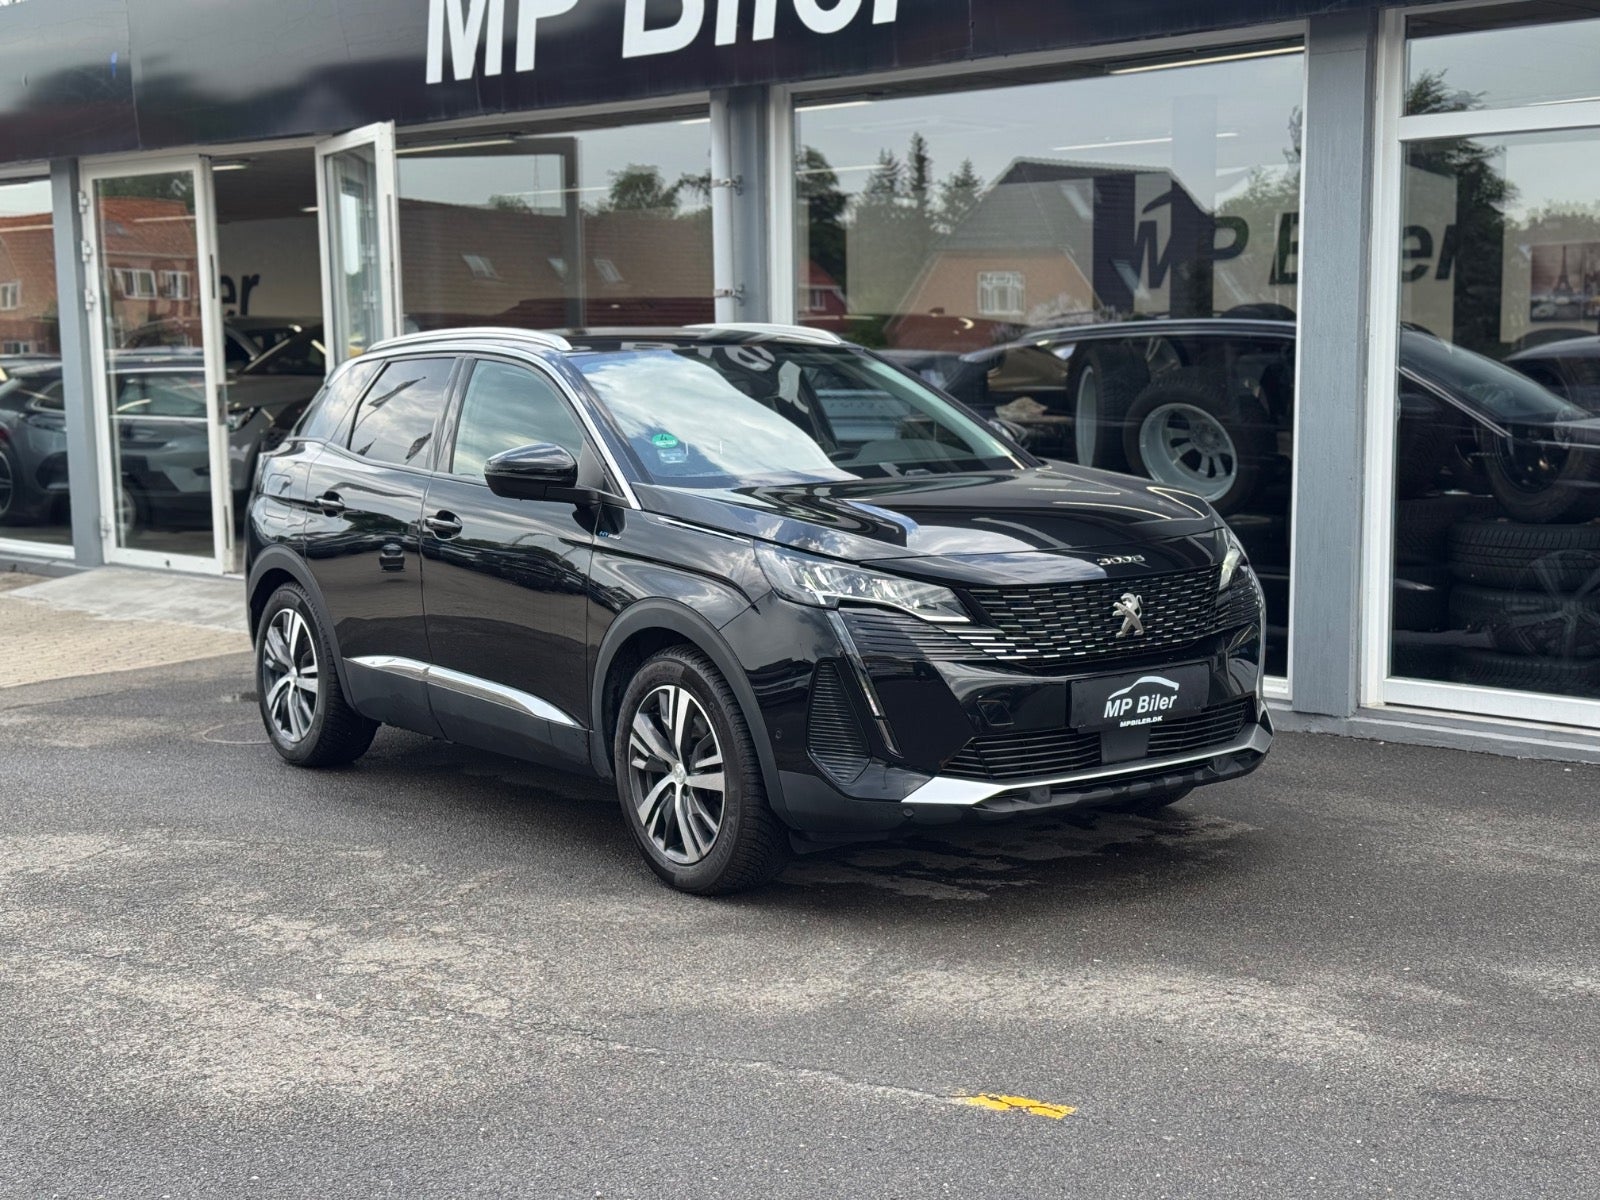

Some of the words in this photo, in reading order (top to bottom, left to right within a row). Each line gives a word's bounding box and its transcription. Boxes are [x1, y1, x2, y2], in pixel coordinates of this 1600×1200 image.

[1096, 554, 1146, 567] 3008
[1103, 698, 1133, 718] MP
[1137, 693, 1178, 713] Biler
[1119, 715, 1163, 728] MPBILER.DK
